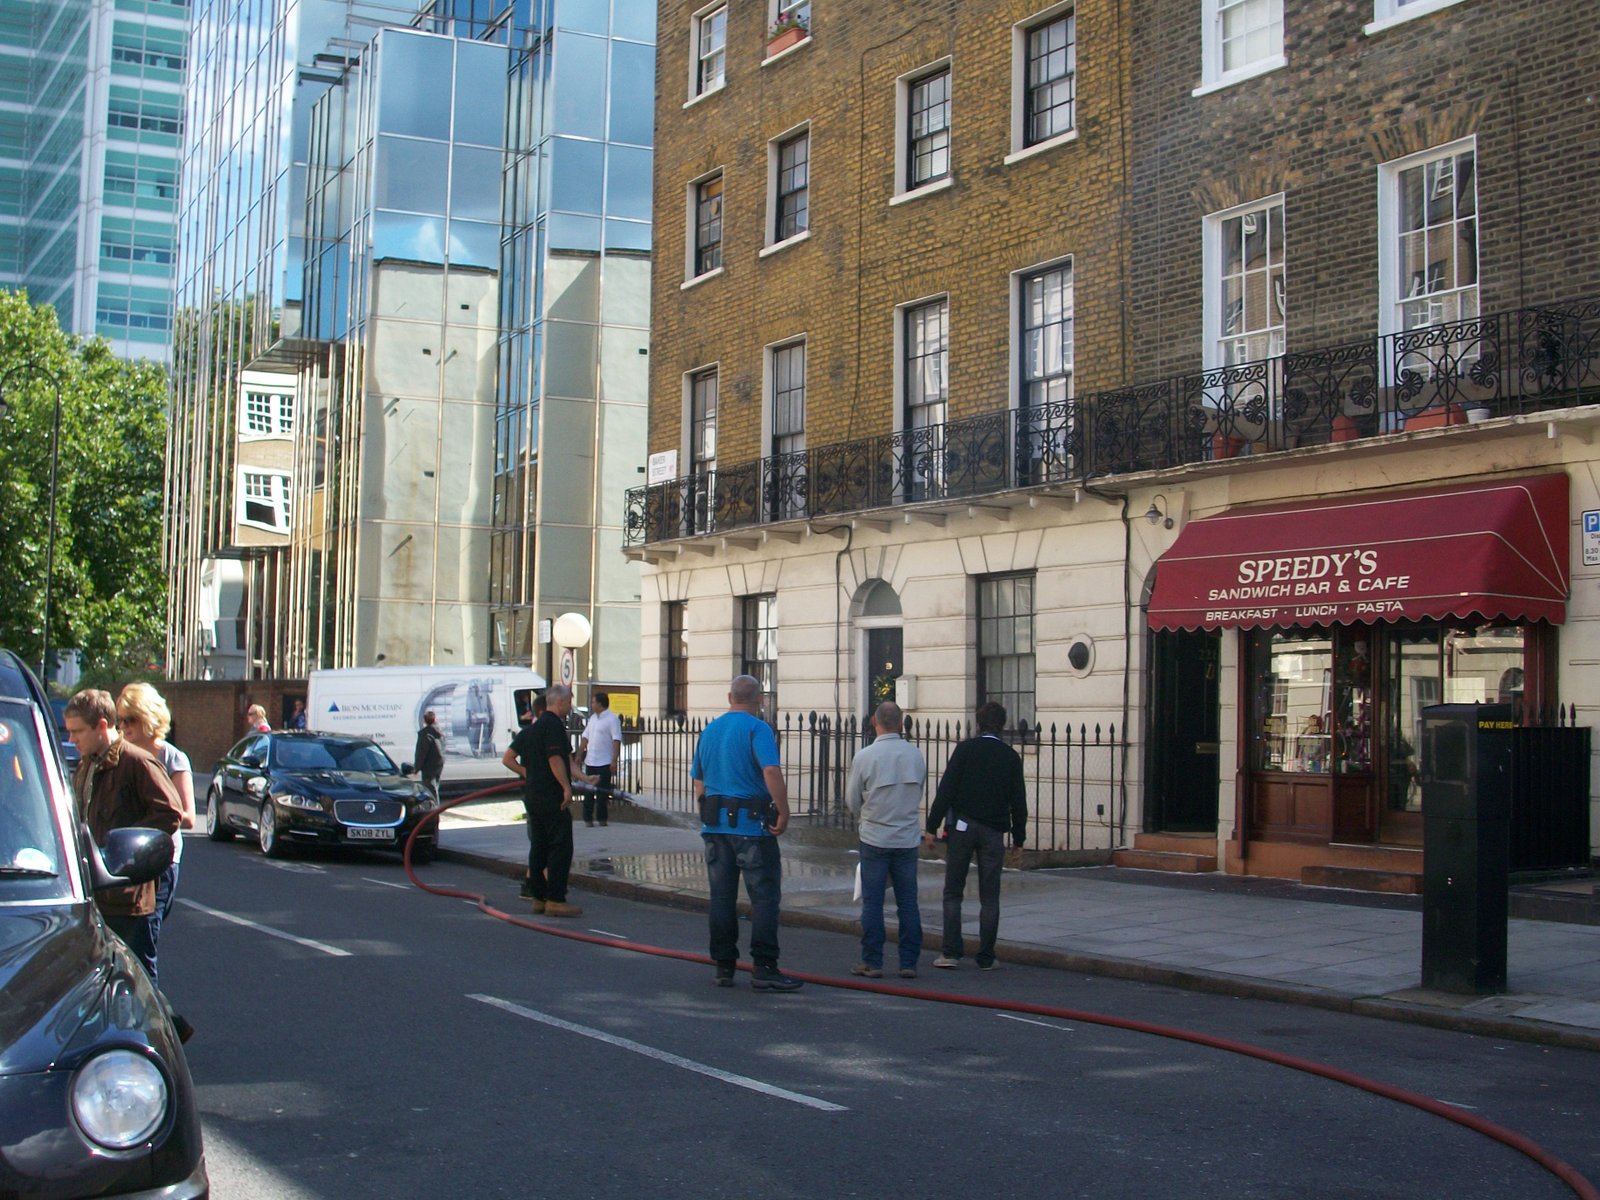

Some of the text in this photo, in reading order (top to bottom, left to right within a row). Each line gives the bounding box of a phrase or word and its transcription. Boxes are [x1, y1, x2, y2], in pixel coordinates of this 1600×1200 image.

[1588, 515, 1598, 531] P
[1237, 549, 1378, 584] SPEEDY'S
[1208, 575, 1410, 601] SANDWICH BAR & CAFE
[1205, 600, 1404, 622] BREAKFAST LUNCH PASTA
[564, 659, 570, 679] 5
[341, 704, 401, 712] IRON MOUNTAIN
[1478, 721, 1495, 729] PAY
